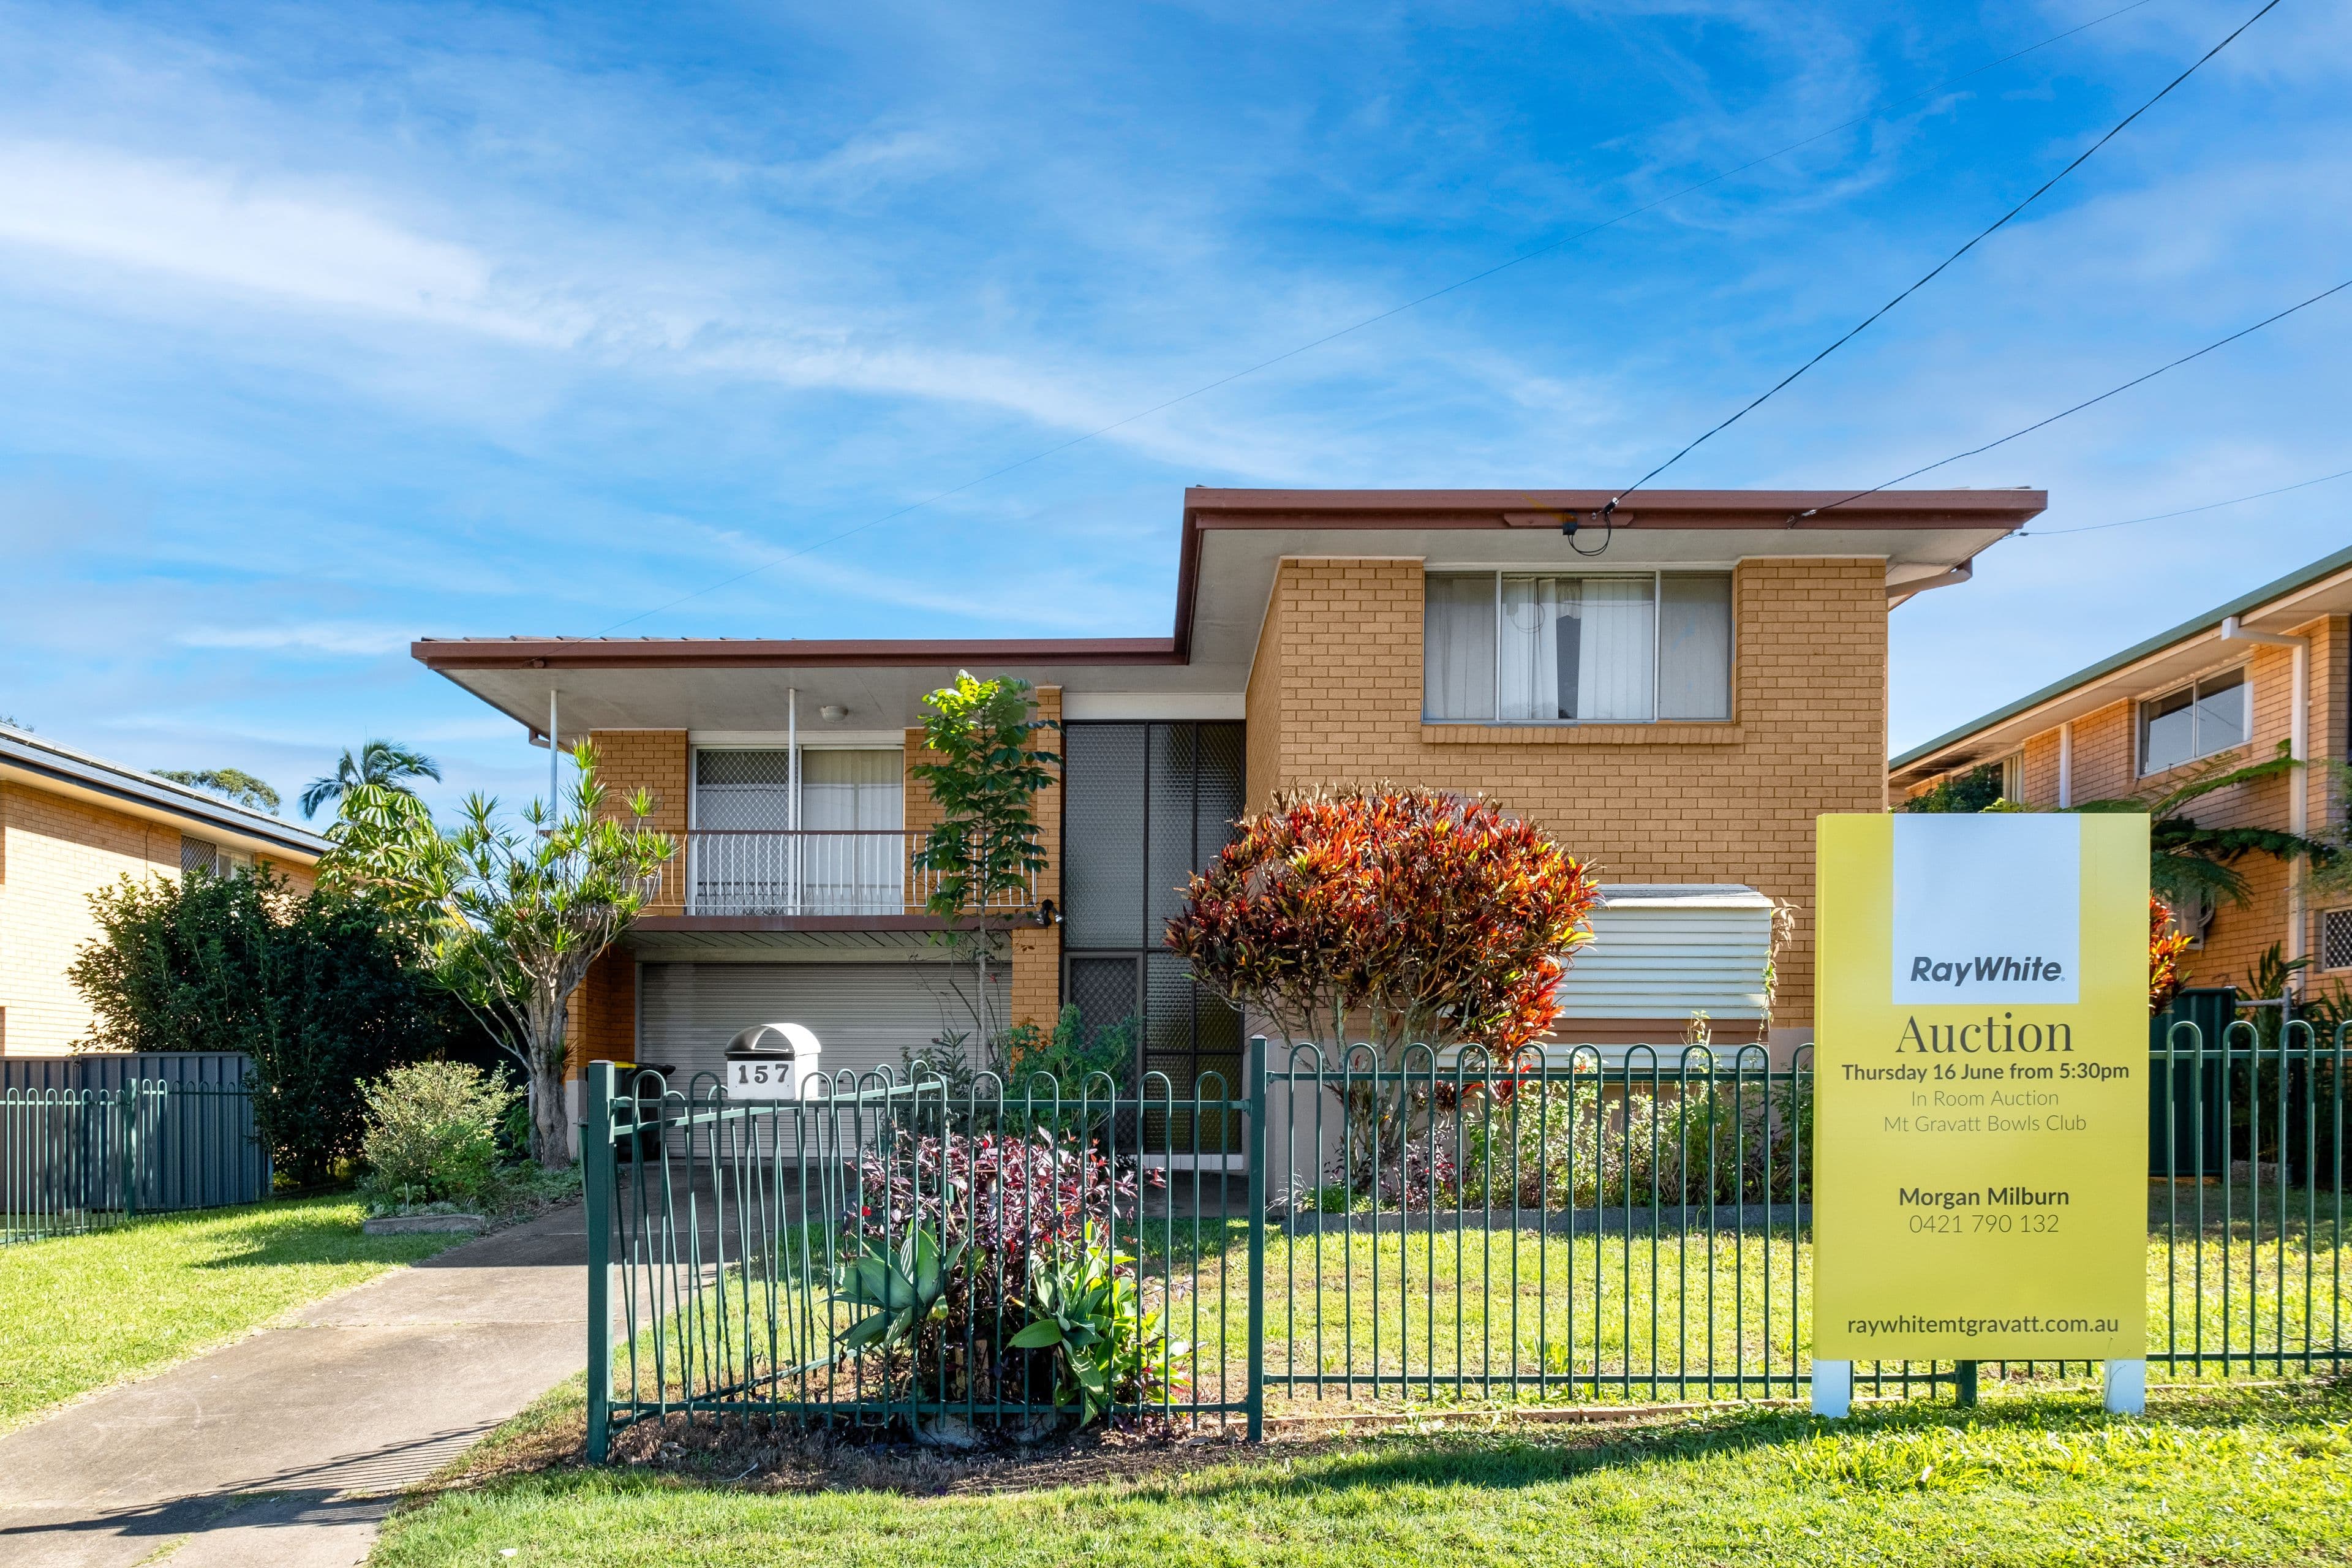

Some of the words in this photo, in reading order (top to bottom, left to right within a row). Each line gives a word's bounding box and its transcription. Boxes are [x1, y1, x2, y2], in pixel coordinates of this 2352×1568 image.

[1894, 1012, 2075, 1054] Auction
[737, 1063, 790, 1084] 157
[1841, 1063, 1928, 1084] Thursday
[1933, 1063, 1956, 1080] 16
[1961, 1063, 2004, 1080] June
[2009, 1063, 2053, 1079] from
[2059, 1062, 2129, 1082] 5:30pm
[1912, 1091, 1926, 1106] In
[1934, 1090, 1984, 1106] Room
[1991, 1090, 2059, 1106] Auction
[1884, 1116, 1909, 1132] Mt
[1915, 1115, 1981, 1132] Gravatt
[1988, 1115, 2040, 1131] Bowls
[2046, 1114, 2086, 1131] Club
[1899, 1188, 1980, 1210] Morgan
[1988, 1186, 2069, 1205] Milburn
[1909, 1215, 1962, 1233] 0421
[1972, 1215, 2012, 1233] 790
[2021, 1214, 2059, 1233] 132
[1848, 1314, 2119, 1337] raywhitemtgravatt.com.au
